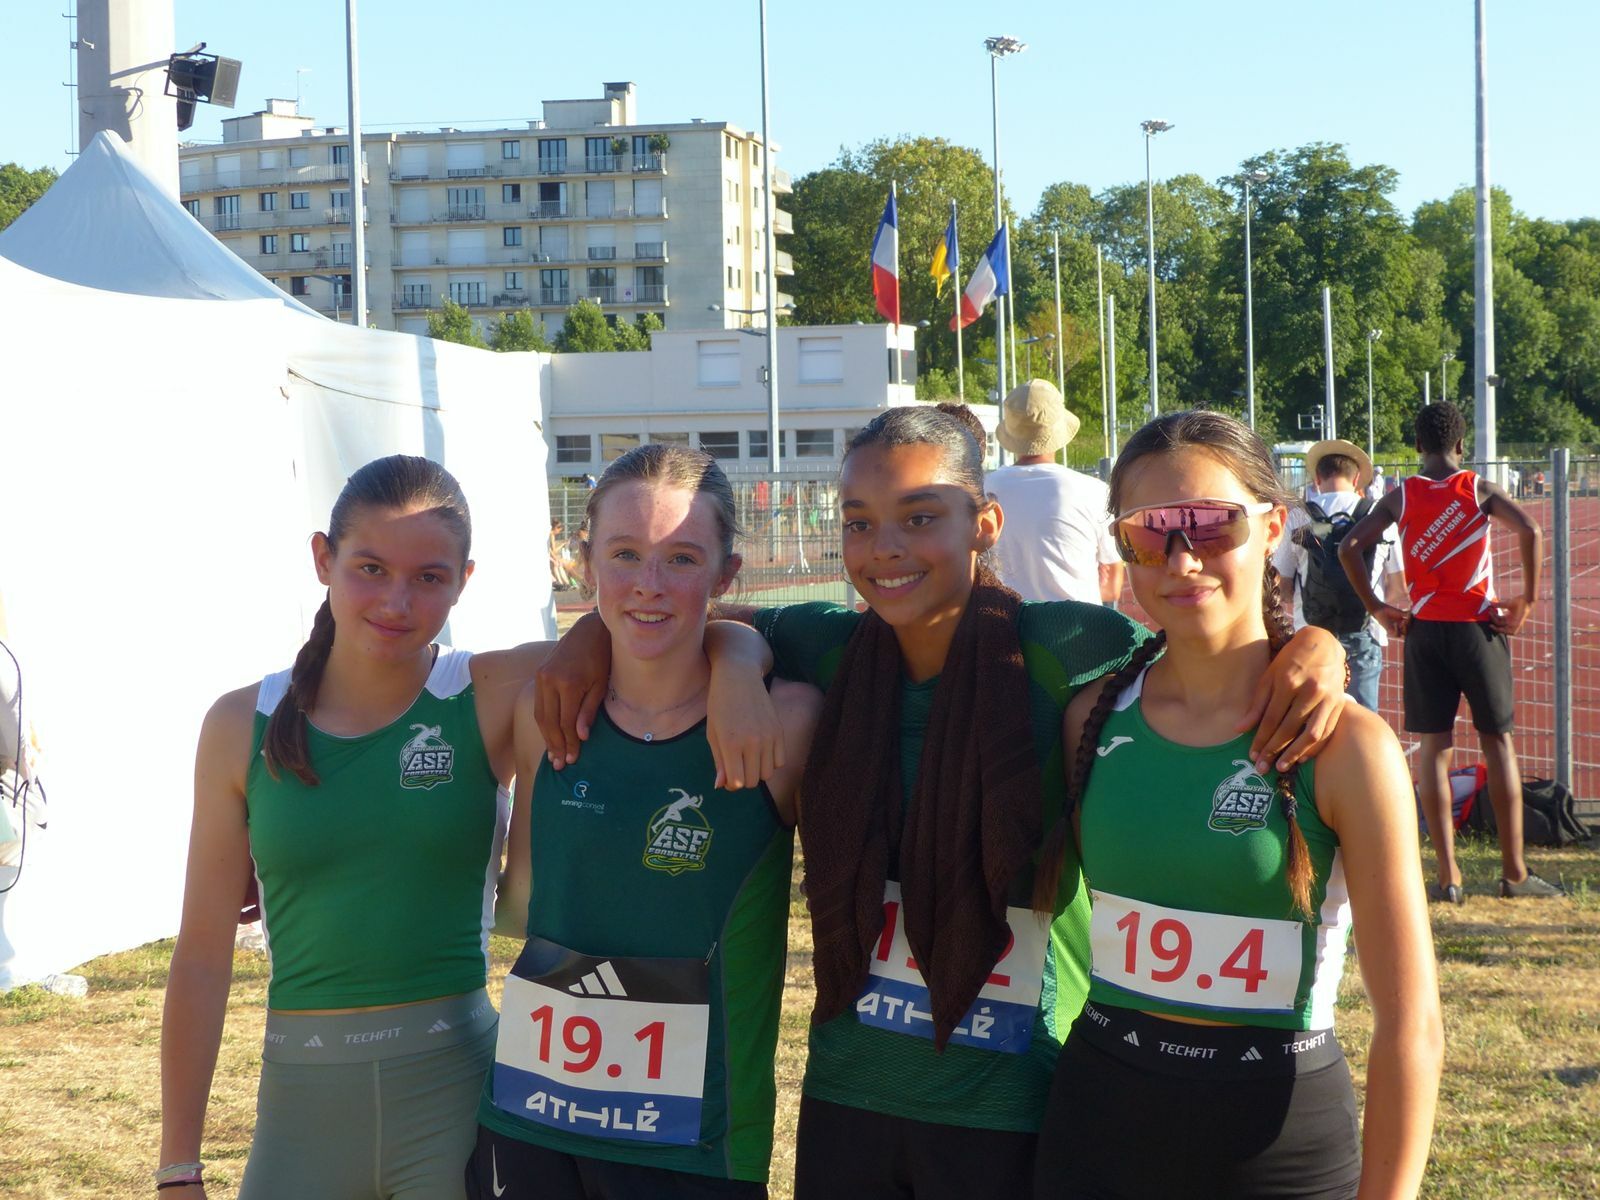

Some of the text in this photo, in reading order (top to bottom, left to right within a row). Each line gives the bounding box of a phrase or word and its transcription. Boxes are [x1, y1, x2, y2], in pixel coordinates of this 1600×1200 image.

[1410, 537, 1427, 558] SPN
[1423, 499, 1462, 539] VERNON
[1419, 510, 1467, 563] ATHLÉTISME
[407, 751, 451, 771] ASF
[1218, 791, 1270, 813] ASF
[652, 825, 710, 853] ASF
[1116, 910, 1269, 993] 19.4
[344, 1026, 403, 1045] TECHFIT
[529, 1004, 666, 1079] 19.1
[1159, 1041, 1218, 1060] TECHFIT
[1282, 1032, 1327, 1055] TECHFIT
[525, 1090, 660, 1133] ATHLÉ
